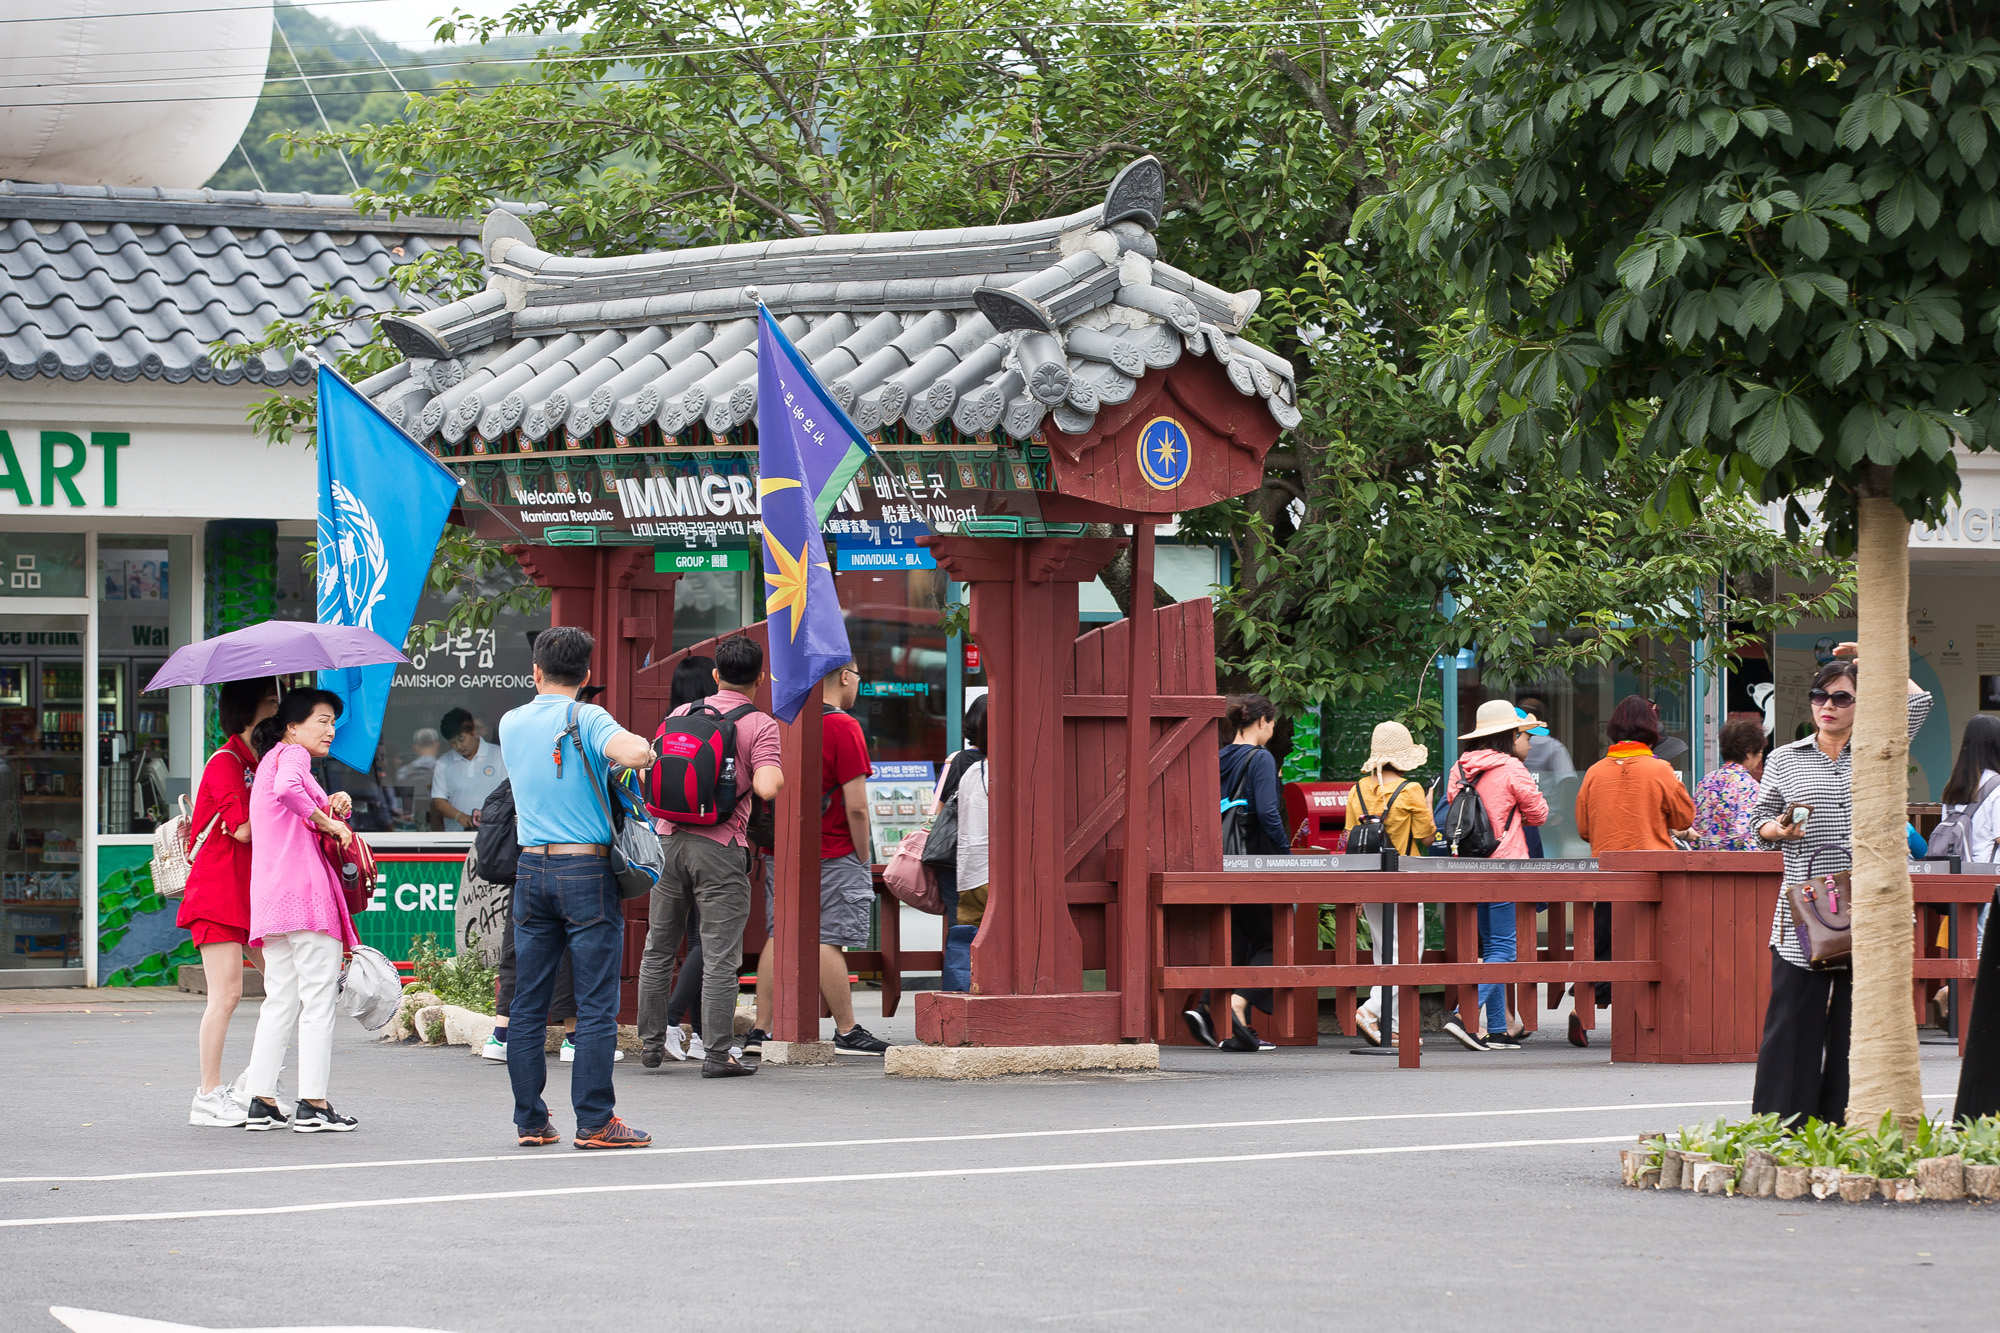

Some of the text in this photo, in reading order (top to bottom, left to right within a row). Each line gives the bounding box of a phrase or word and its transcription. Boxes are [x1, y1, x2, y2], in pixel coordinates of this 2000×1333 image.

[515, 488, 592, 506] Welcome to
[520, 508, 614, 524] Naminara Republic
[675, 556, 704, 568] GROUP
[851, 553, 898, 566] INDIVIDUAL
[905, 553, 922, 566] 個人
[459, 674, 535, 689] GAPYEONG
[1313, 796, 1336, 807] POST
[1266, 858, 1328, 867] NAMINARA REPUBLIC
[1447, 861, 1506, 870] NAMINARA REPUBLIC
[394, 883, 457, 911] CRE
